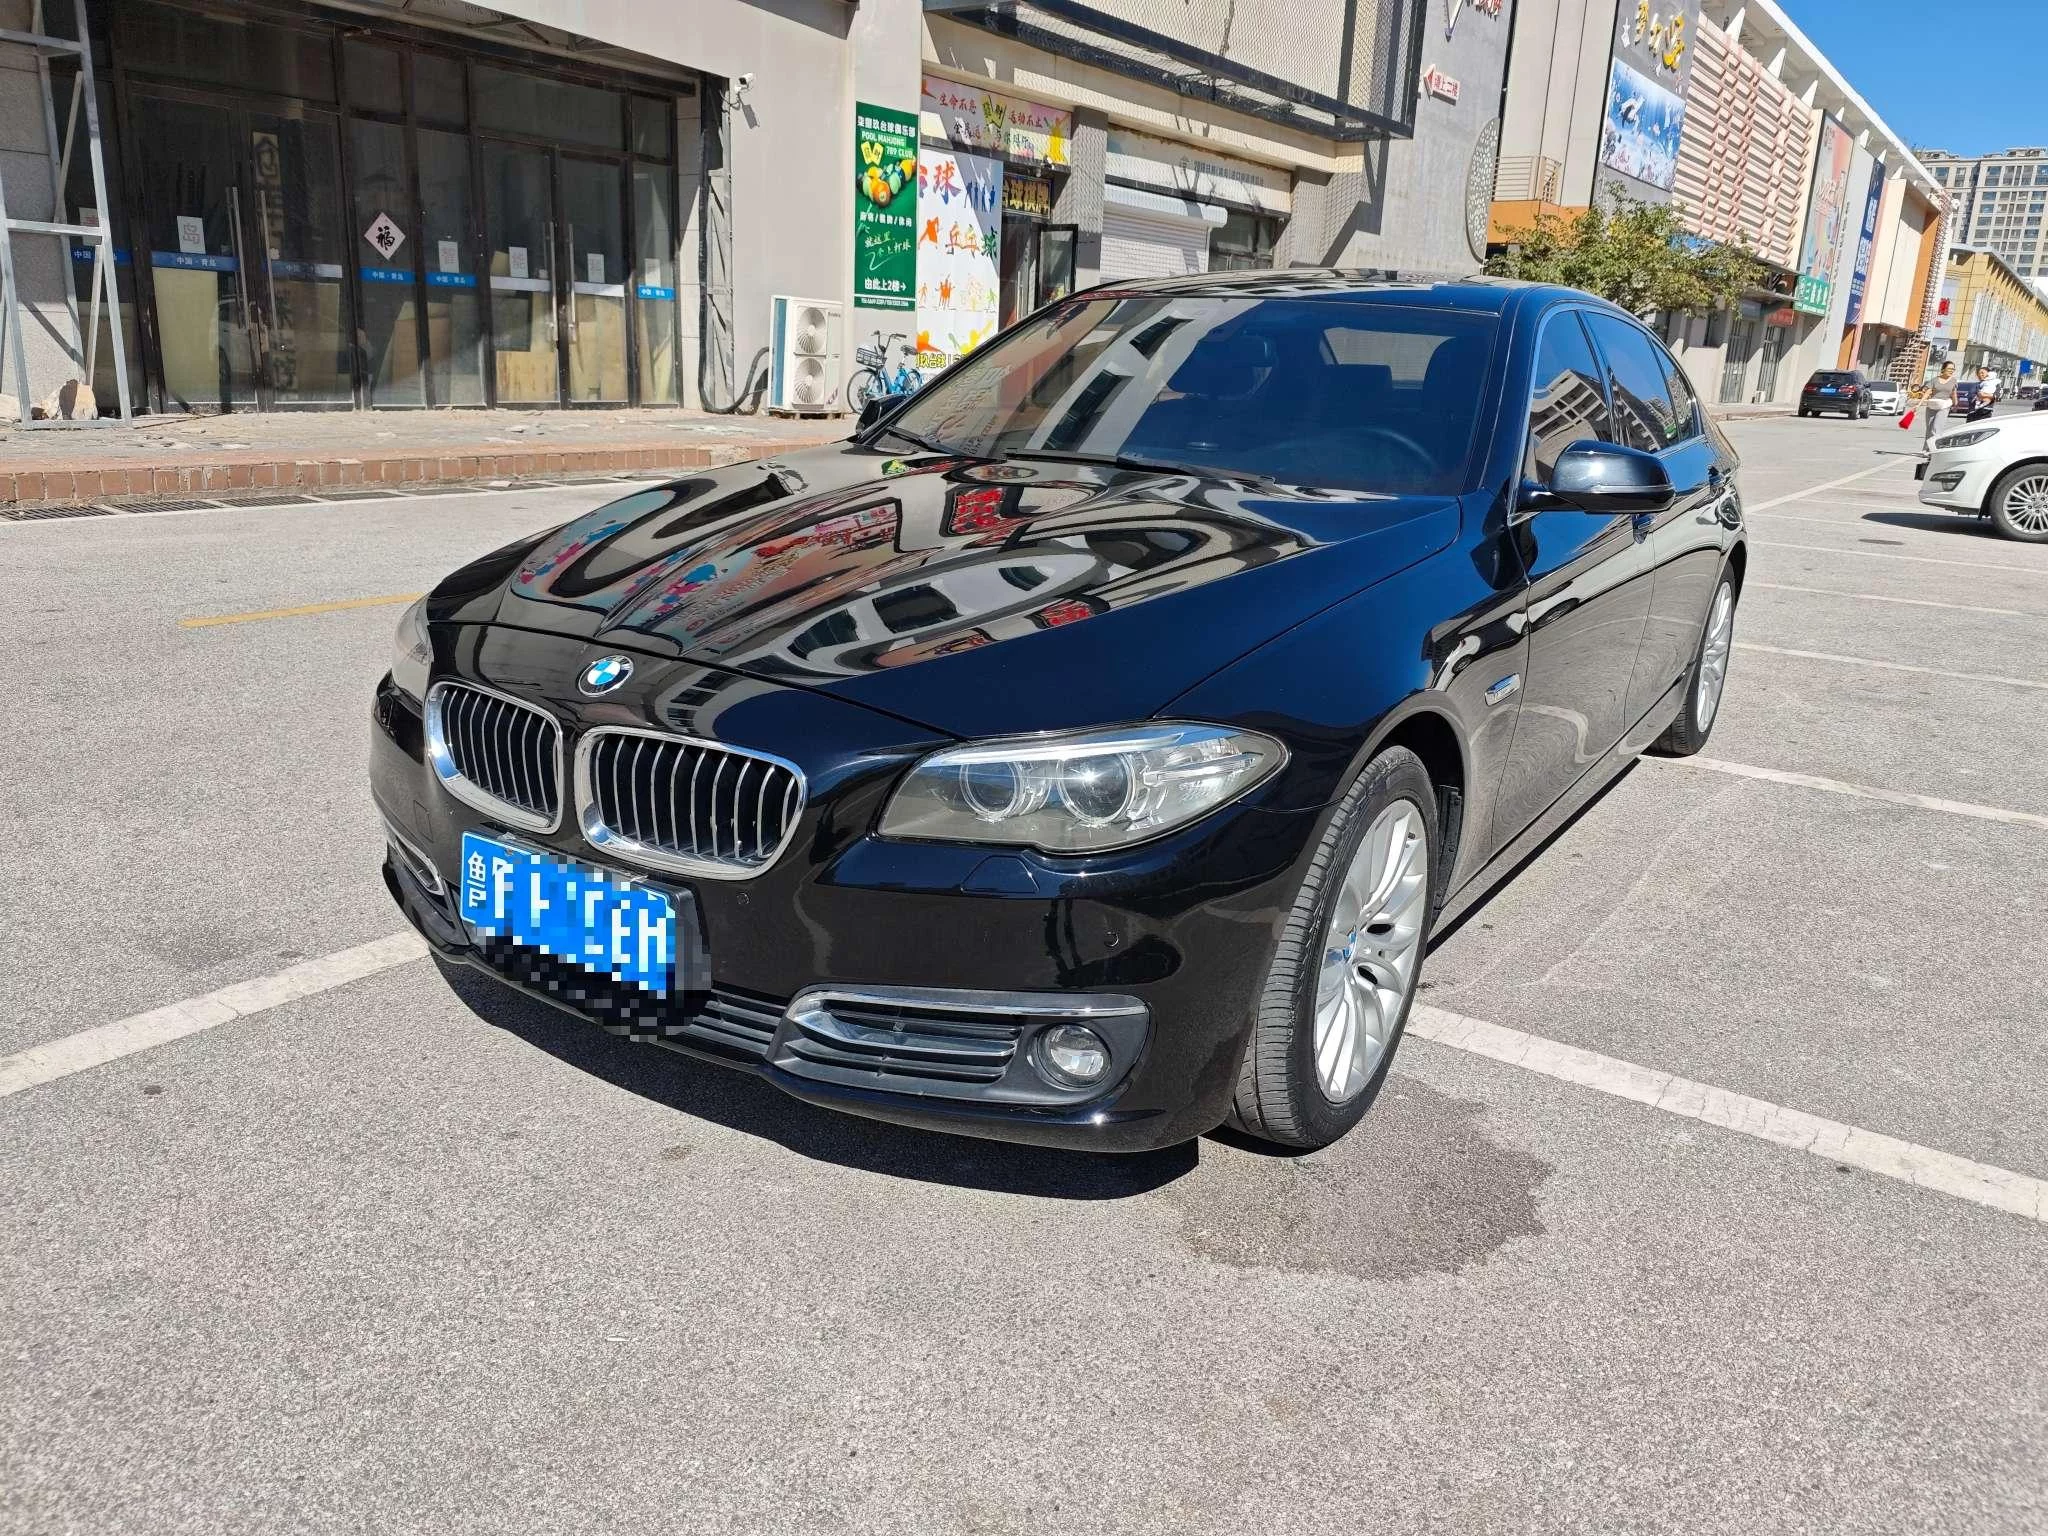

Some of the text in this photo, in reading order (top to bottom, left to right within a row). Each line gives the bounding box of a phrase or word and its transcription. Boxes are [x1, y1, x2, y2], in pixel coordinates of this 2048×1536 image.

[939, 93, 977, 115] 生命不息
[861, 130, 877, 142] POOL
[375, 225, 396, 251] 福
[864, 277, 900, 292] 由此上2楼
